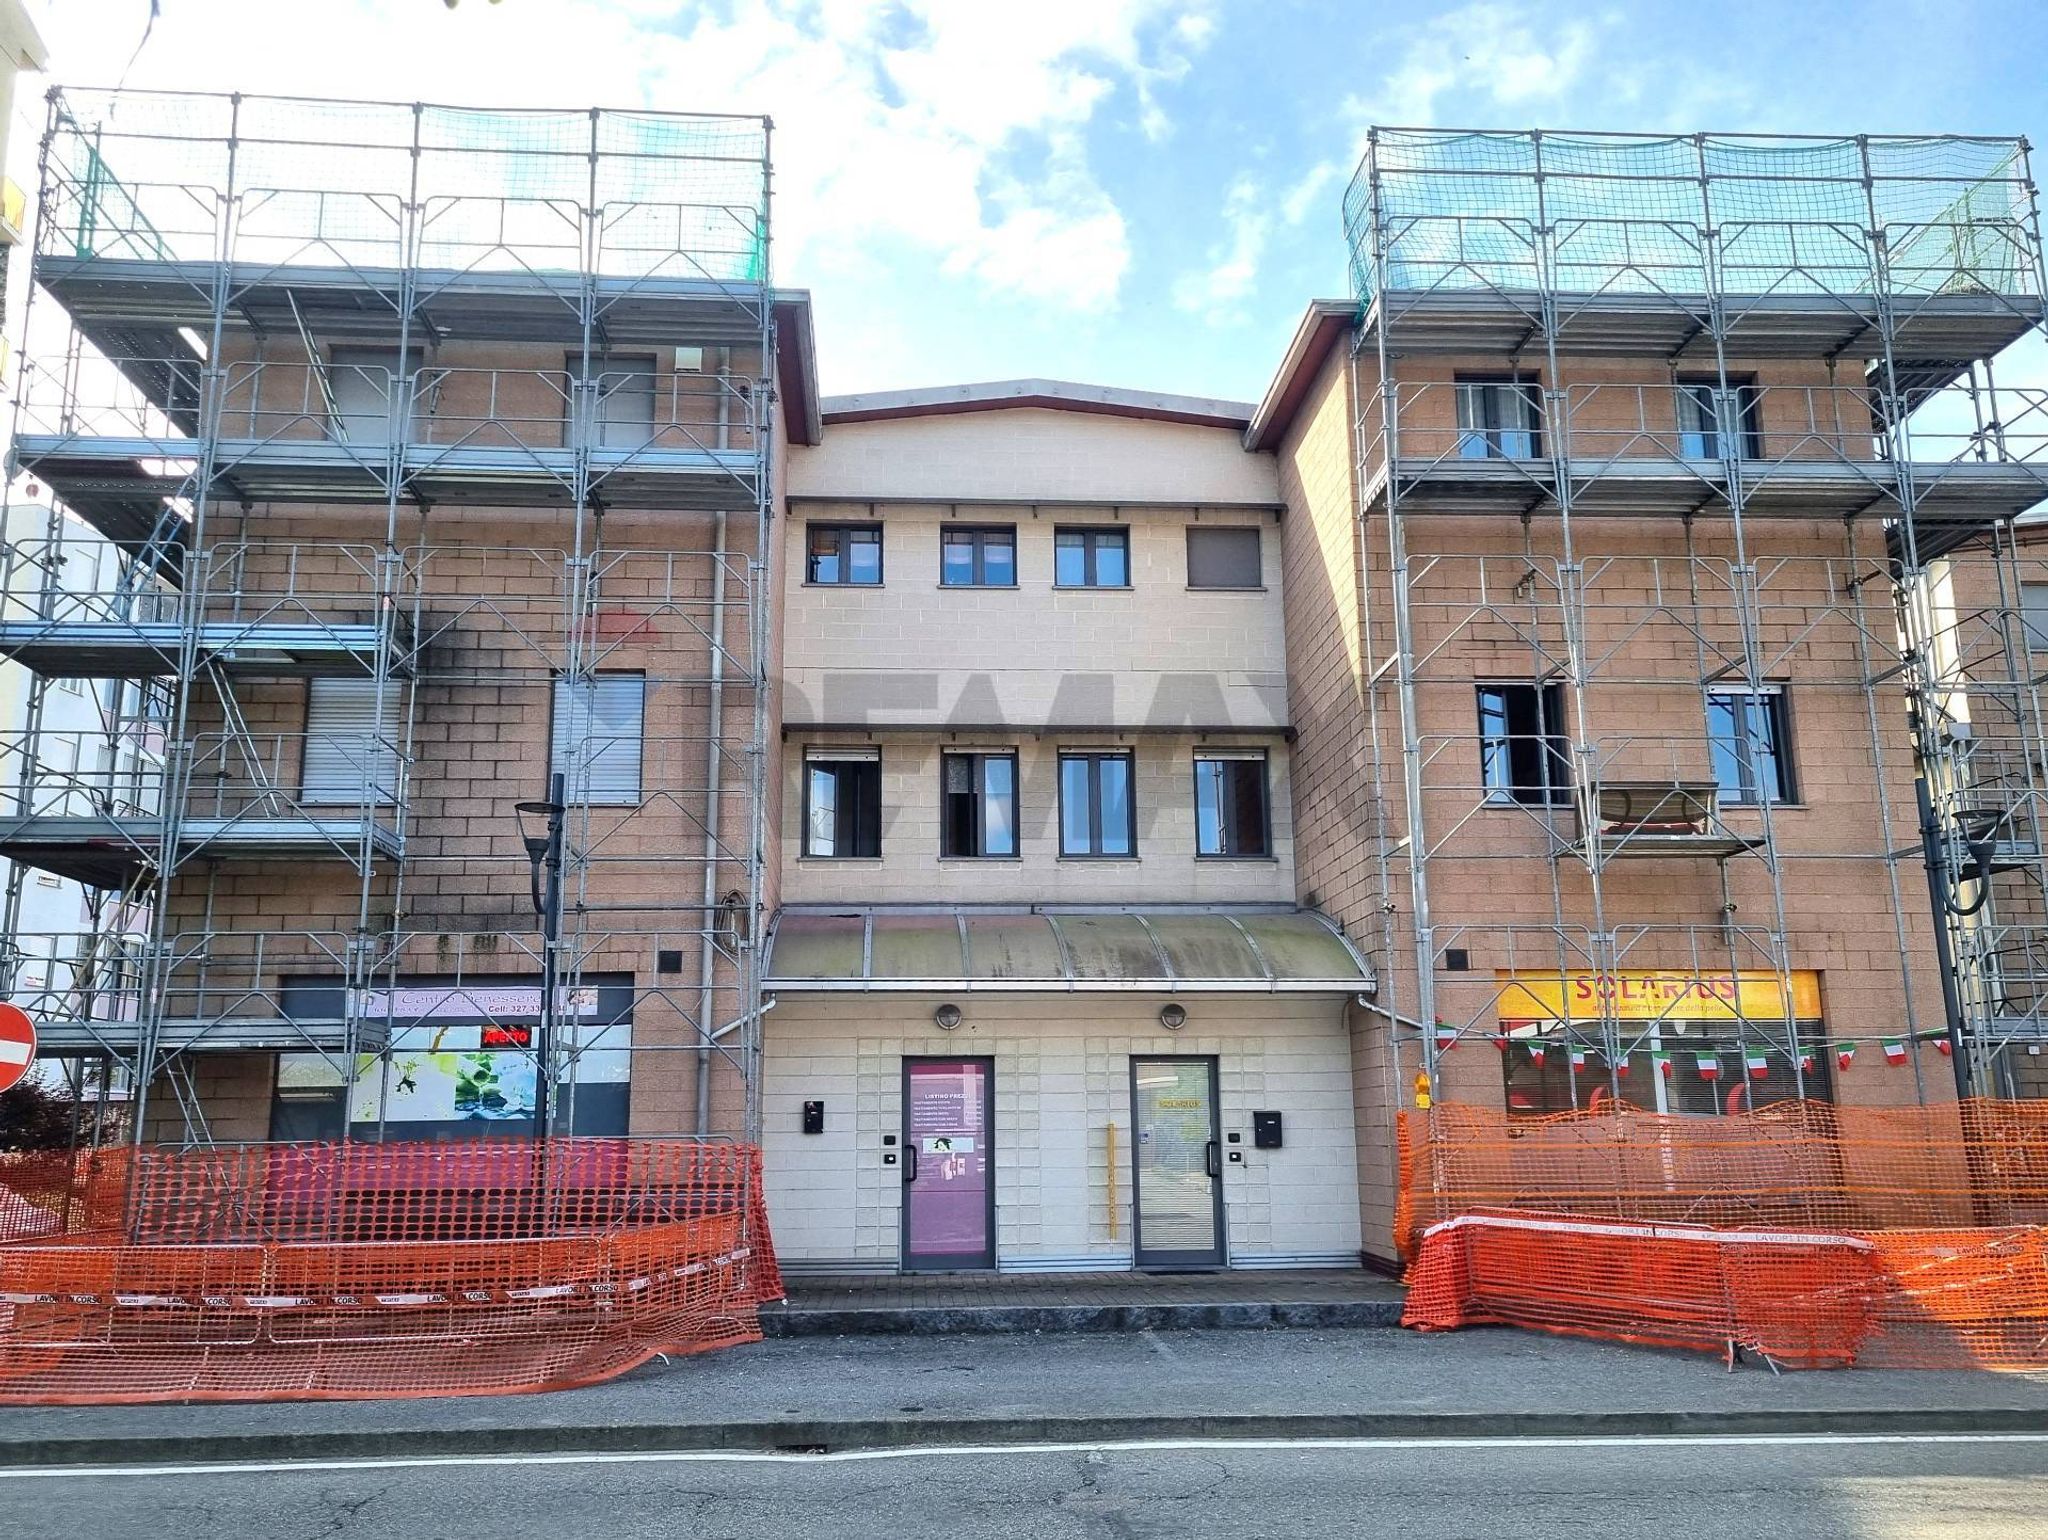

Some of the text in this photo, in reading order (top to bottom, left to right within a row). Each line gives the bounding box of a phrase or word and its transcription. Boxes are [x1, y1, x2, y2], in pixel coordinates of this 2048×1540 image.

[1576, 975, 1735, 999] SOLARIUS
[402, 991, 455, 1004] Centro
[488, 1005, 508, 1013] Cell:
[484, 1030, 529, 1043] APERTO
[1812, 1236, 1846, 1244] CORSO
[594, 1284, 619, 1292] CORSO
[467, 1291, 493, 1300] CORSO
[75, 1296, 102, 1304] CORSO
[207, 1297, 233, 1305] CORSO
[337, 1296, 362, 1304] CORSO
